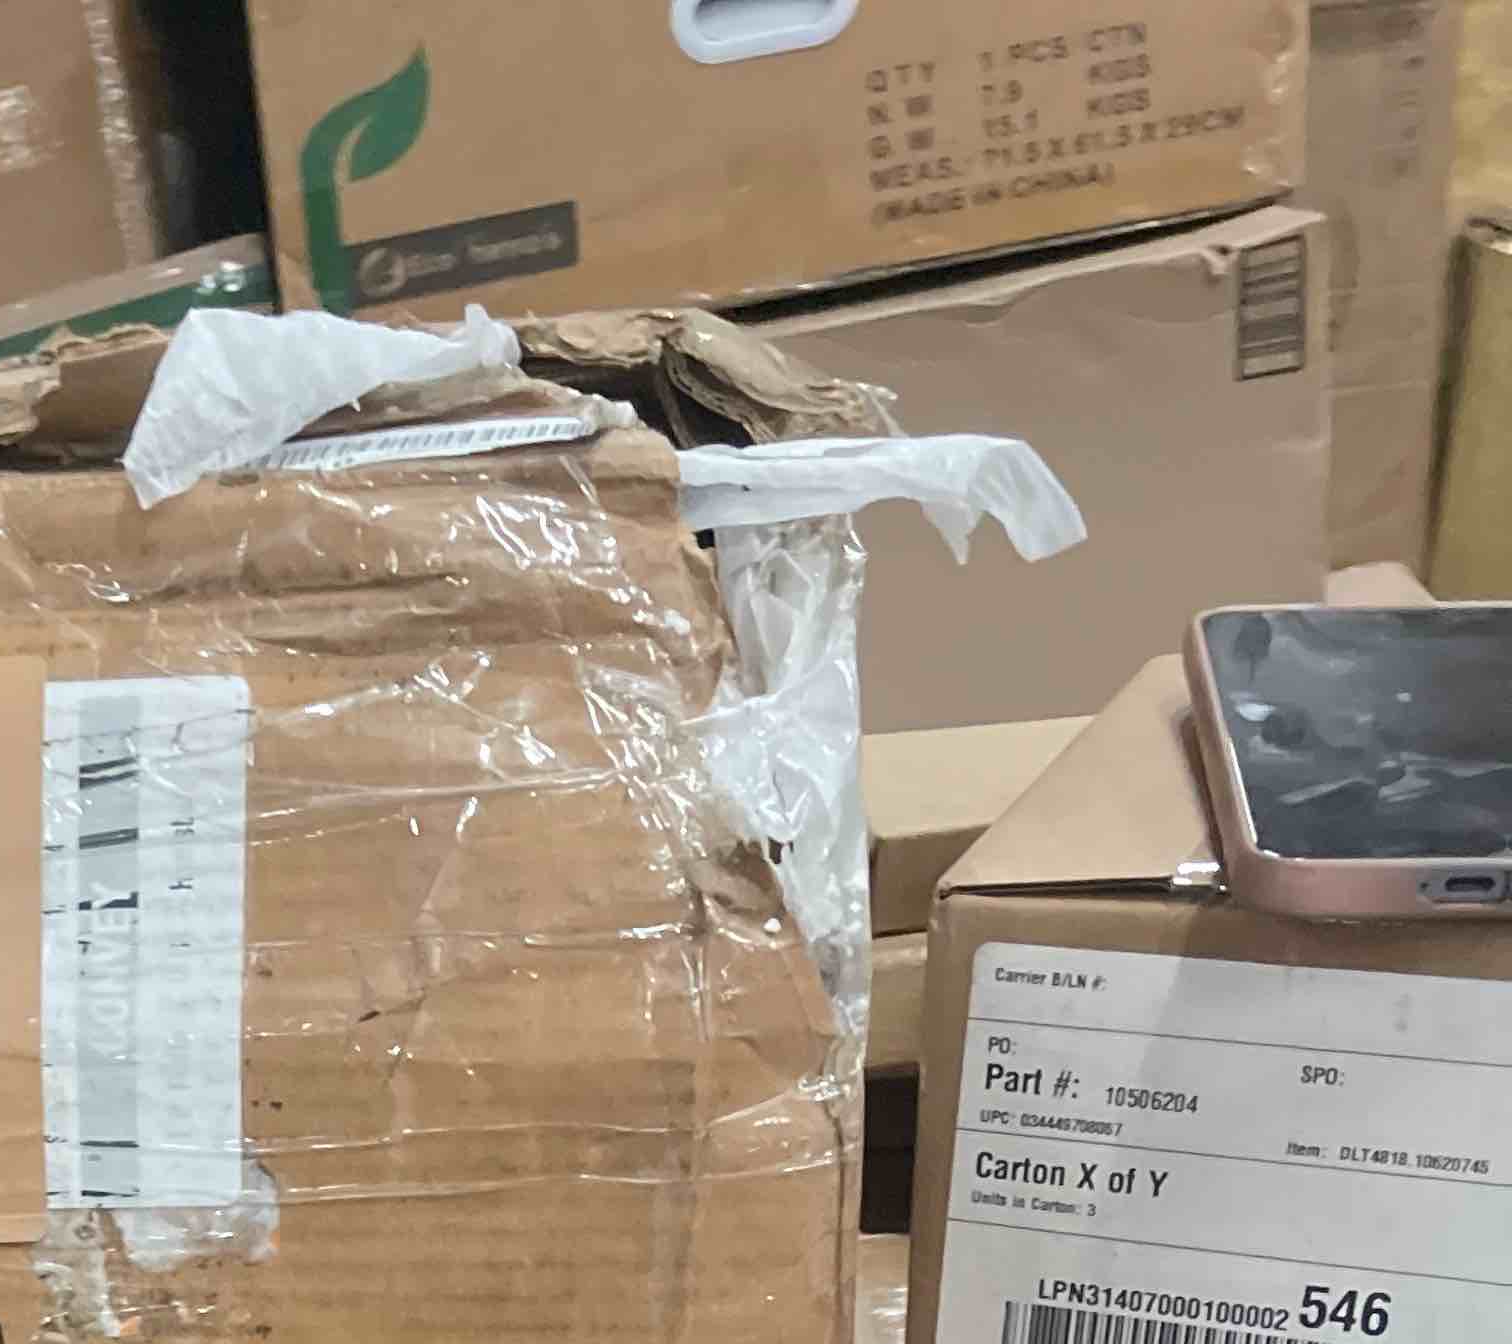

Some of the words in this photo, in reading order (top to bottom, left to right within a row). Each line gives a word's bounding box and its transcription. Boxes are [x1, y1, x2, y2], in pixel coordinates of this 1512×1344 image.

[994, 967, 1047, 987] Carrier
[988, 1036, 1018, 1057] PO:
[1300, 1064, 1347, 1088] SPO:
[984, 1063, 1043, 1098] Part
[1052, 1070, 1081, 1101] #:
[1104, 1085, 1199, 1114] 10506204
[975, 1152, 1065, 1188] Carton
[1076, 1162, 1099, 1191] X
[1108, 1166, 1136, 1195] of
[1147, 1170, 1169, 1198] Y
[1087, 1202, 1097, 1217] 3
[1037, 1278, 1289, 1332] LPN31407000100002
[1299, 1285, 1391, 1337] 546
